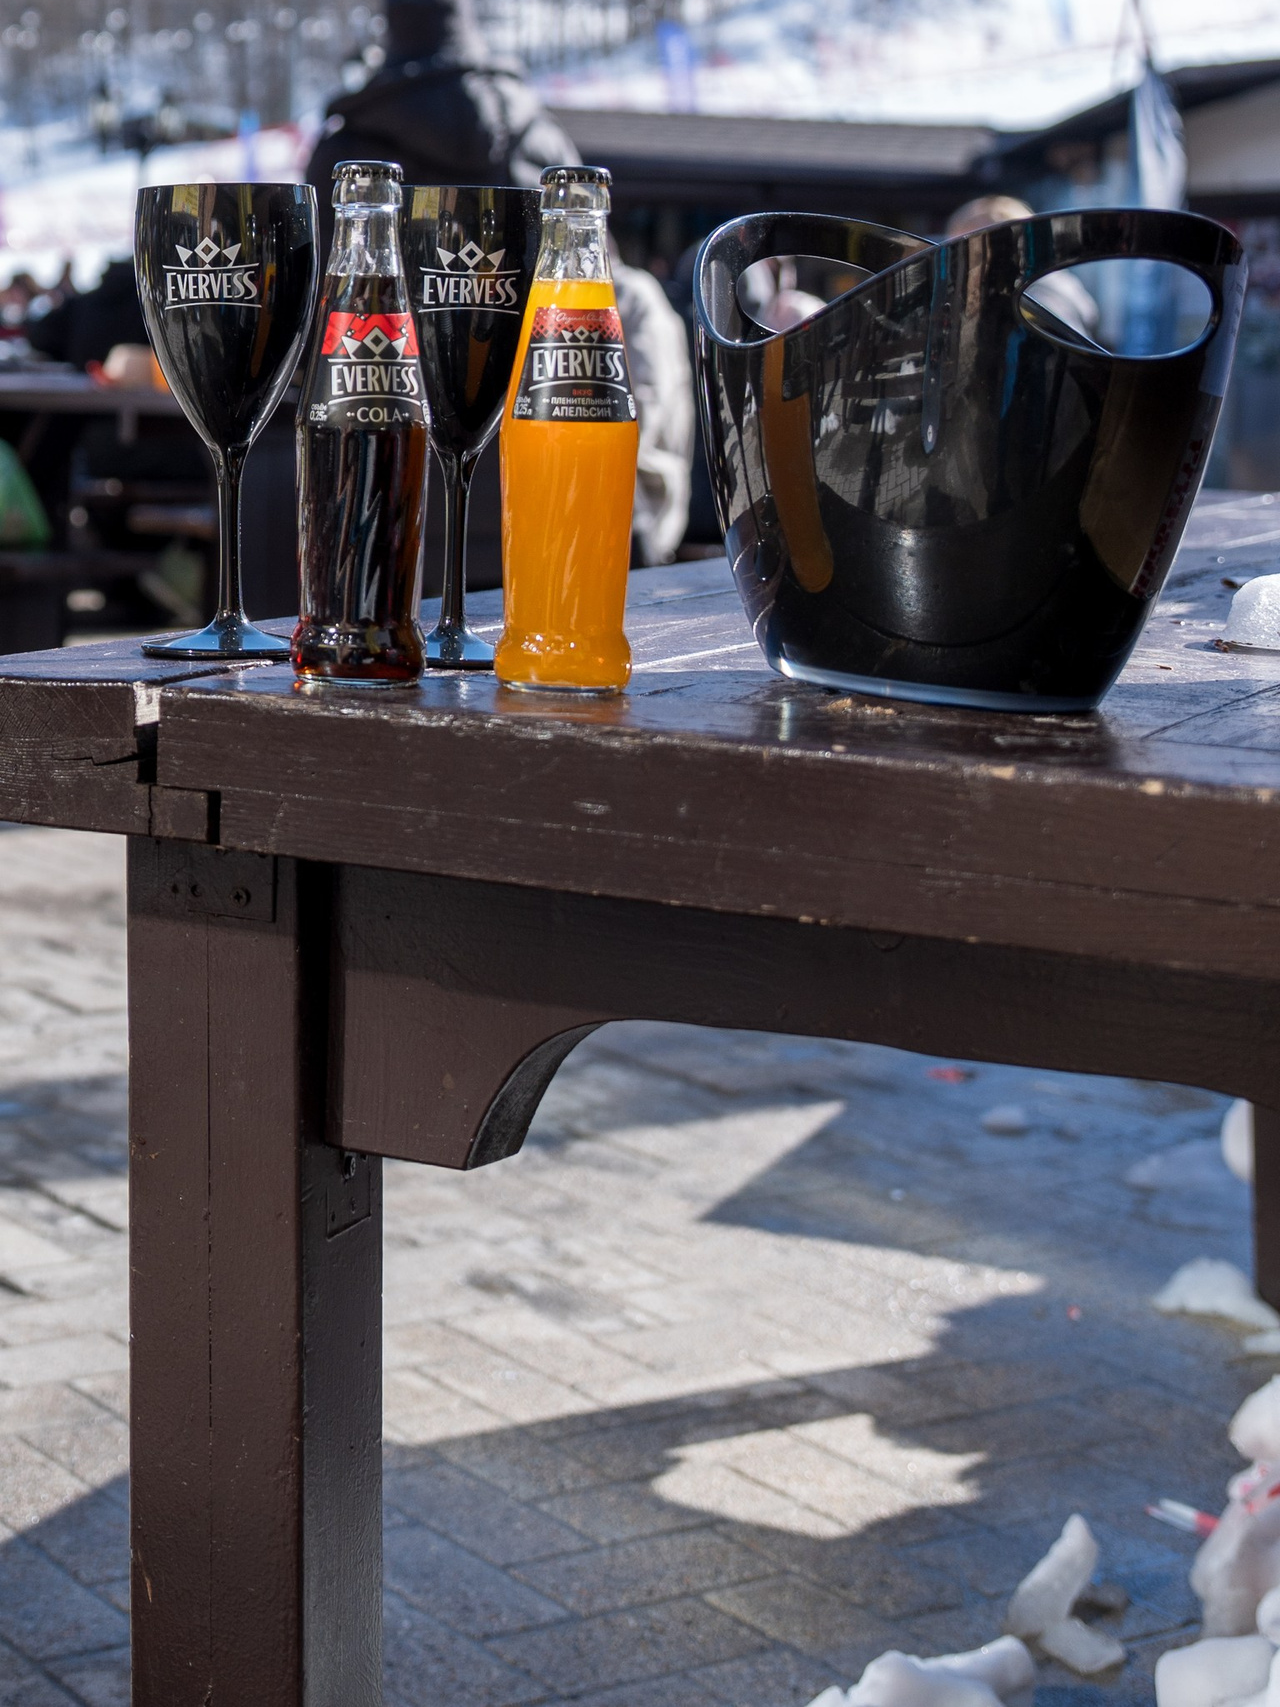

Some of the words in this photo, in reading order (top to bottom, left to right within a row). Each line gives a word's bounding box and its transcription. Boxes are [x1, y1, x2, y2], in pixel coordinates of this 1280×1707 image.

[166, 270, 258, 302] EVERVESS
[423, 275, 518, 307] EVERVESS
[332, 364, 419, 396] EVERVESS
[533, 349, 625, 382] EVERVESS
[357, 406, 402, 423] COLA
[551, 396, 611, 405] ПЛЕНИТЕЛЬНЫЙ
[552, 406, 611, 417] АПЕЛЬСИН
